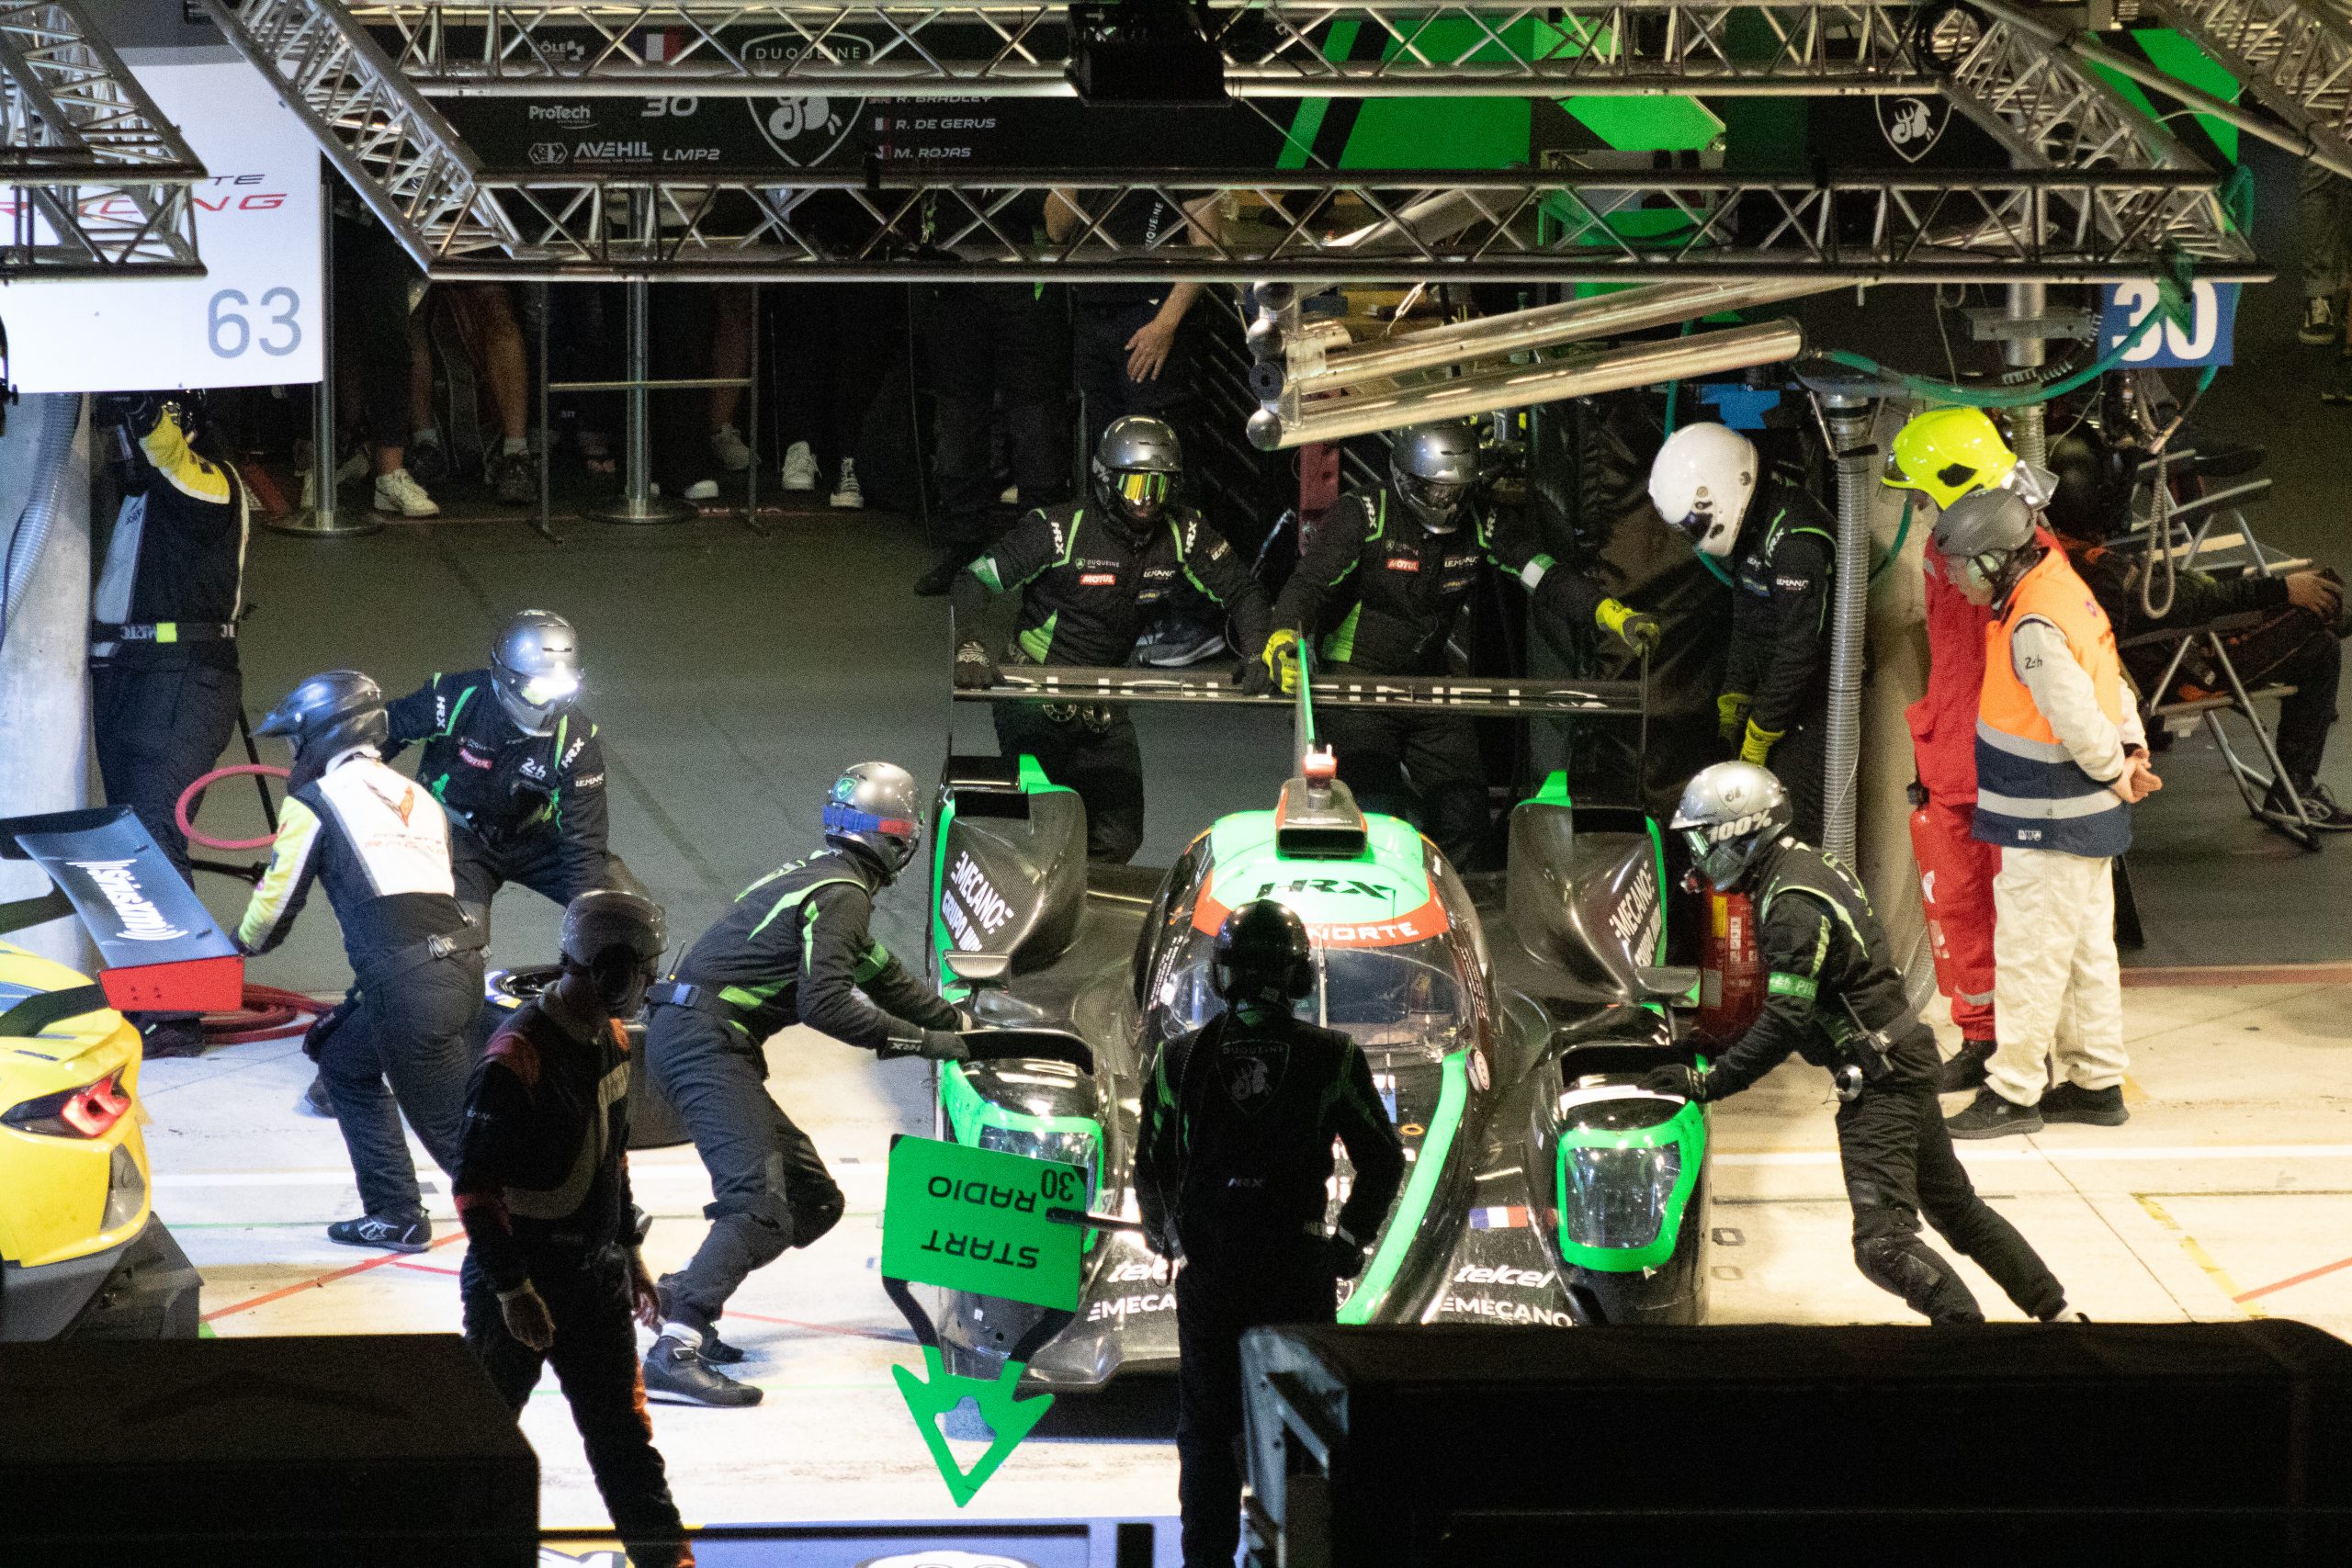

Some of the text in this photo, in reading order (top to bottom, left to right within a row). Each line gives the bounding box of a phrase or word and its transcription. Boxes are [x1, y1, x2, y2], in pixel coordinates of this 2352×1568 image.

[528, 106, 591, 119] ProTech
[915, 119, 937, 130] DE
[941, 118, 996, 129] GERUS
[662, 149, 720, 161] LMP2
[919, 148, 971, 158] ROJAS
[208, 287, 302, 359] 63
[2113, 279, 2219, 361] 30
[1083, 575, 1114, 584] MOTUL
[560, 737, 585, 768] HRX
[1710, 809, 1772, 843] 100%
[1256, 878, 1395, 901] HRX
[1306, 921, 1419, 942] NORTE
[928, 1176, 1037, 1213] RADIO
[1041, 1168, 1075, 1202] 30
[921, 1229, 1040, 1269] START
[1453, 1264, 1555, 1289] telcel
[1101, 1293, 1177, 1318] MECA
